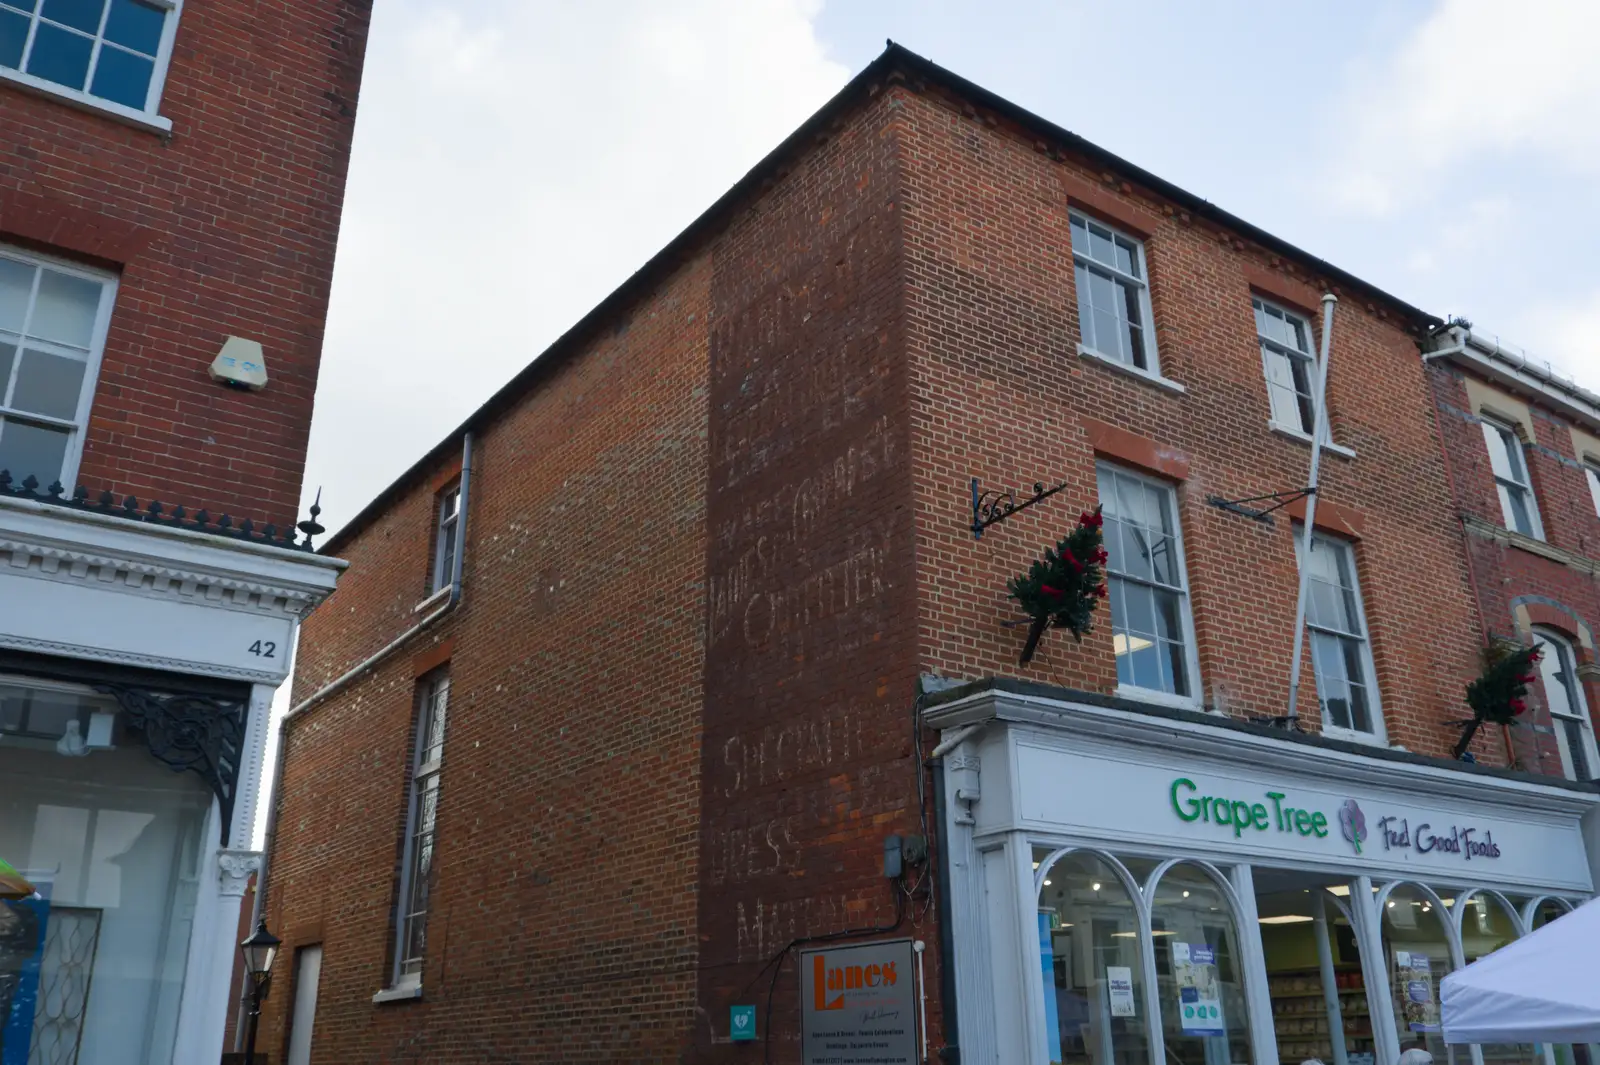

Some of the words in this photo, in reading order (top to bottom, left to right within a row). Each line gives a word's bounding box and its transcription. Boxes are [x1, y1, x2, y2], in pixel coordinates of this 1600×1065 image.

[249, 640, 276, 658] 42
[1171, 778, 1269, 838] Grape
[1266, 791, 1328, 838] Tree
[1377, 815, 1411, 851] Feel
[1415, 822, 1461, 853] Good
[1459, 827, 1501, 861] Foods
[814, 956, 897, 1010] Lanes
